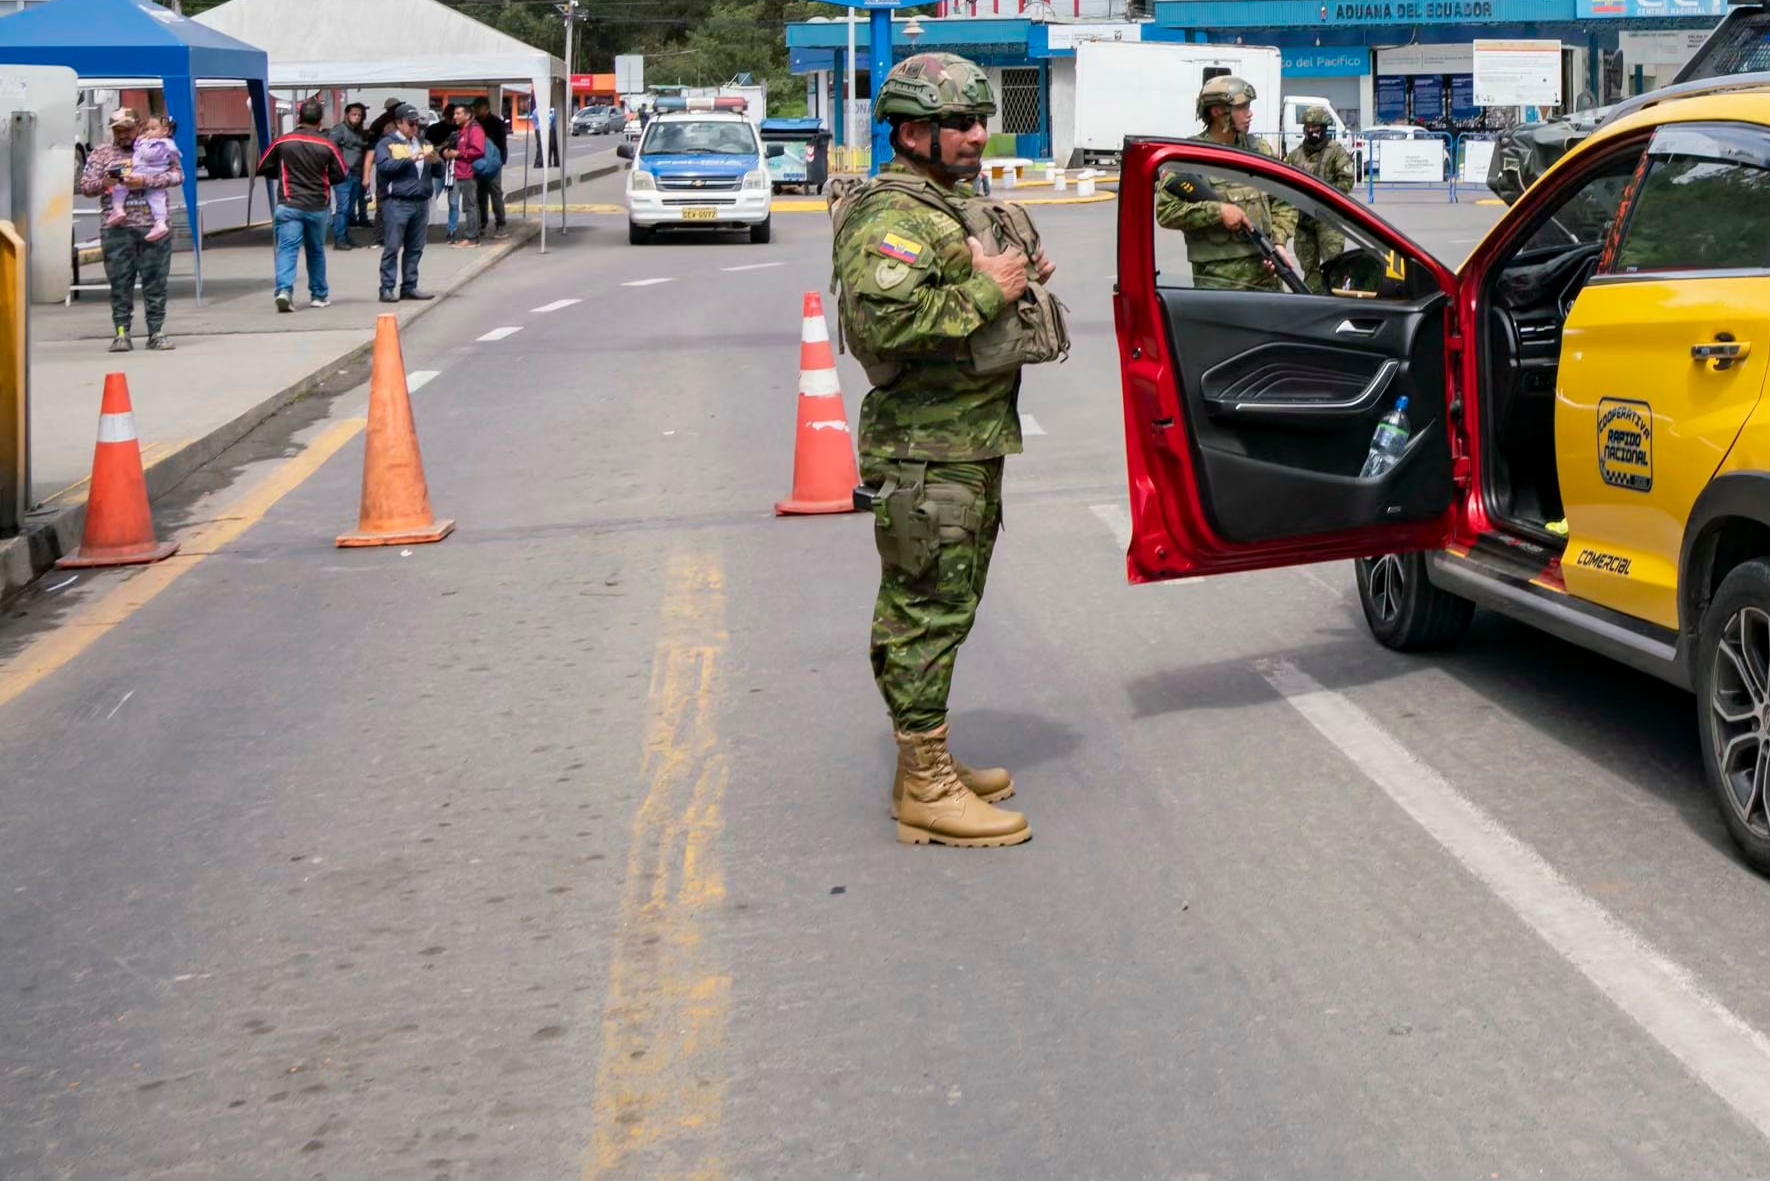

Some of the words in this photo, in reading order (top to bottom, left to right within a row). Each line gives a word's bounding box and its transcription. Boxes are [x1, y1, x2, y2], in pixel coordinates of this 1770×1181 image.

[1336, 3, 1393, 20] ADUANA
[1397, 3, 1421, 19] DEL
[1426, 1, 1493, 19] ECUADOR
[1296, 56, 1313, 68] del
[1599, 406, 1650, 441] COOPERATIVA
[1607, 428, 1642, 447] RAPIDO
[1604, 445, 1649, 467] NACIONAL
[1576, 549, 1632, 575] COMERCIAL
